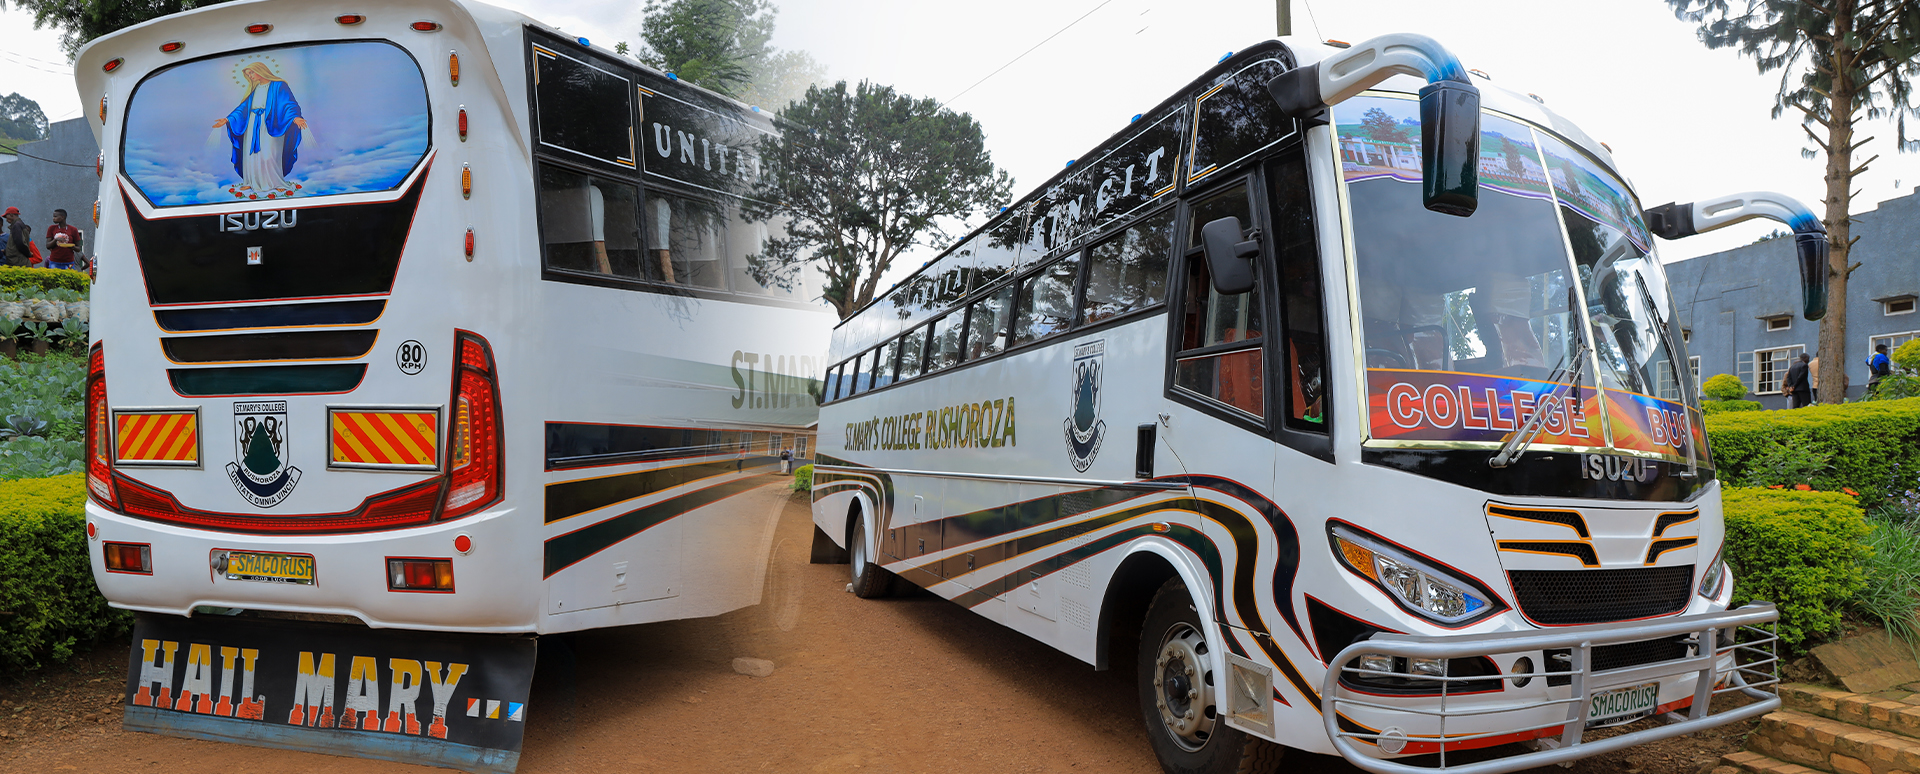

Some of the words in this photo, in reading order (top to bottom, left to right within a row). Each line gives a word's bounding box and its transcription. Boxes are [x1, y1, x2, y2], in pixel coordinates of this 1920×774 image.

[219, 209, 297, 232] ISUZU
[401, 344, 422, 363] 80
[236, 404, 260, 413] ST.MARY'S
[262, 403, 285, 411] COLLEGE
[1387, 382, 1590, 438] COLLEGE
[844, 415, 879, 451] ST.MARY'S
[881, 412, 922, 450] COLLEGE
[925, 396, 1016, 450] RUSHOROZA
[243, 467, 281, 483] RUSHOROZA
[1581, 454, 1647, 482] ISUZU
[230, 471, 253, 501] UNITATE
[254, 496, 276, 506] OMNIA
[276, 477, 296, 500] VINCIT
[133, 639, 265, 720] HAIL
[1590, 685, 1658, 718] SMACORUSH
